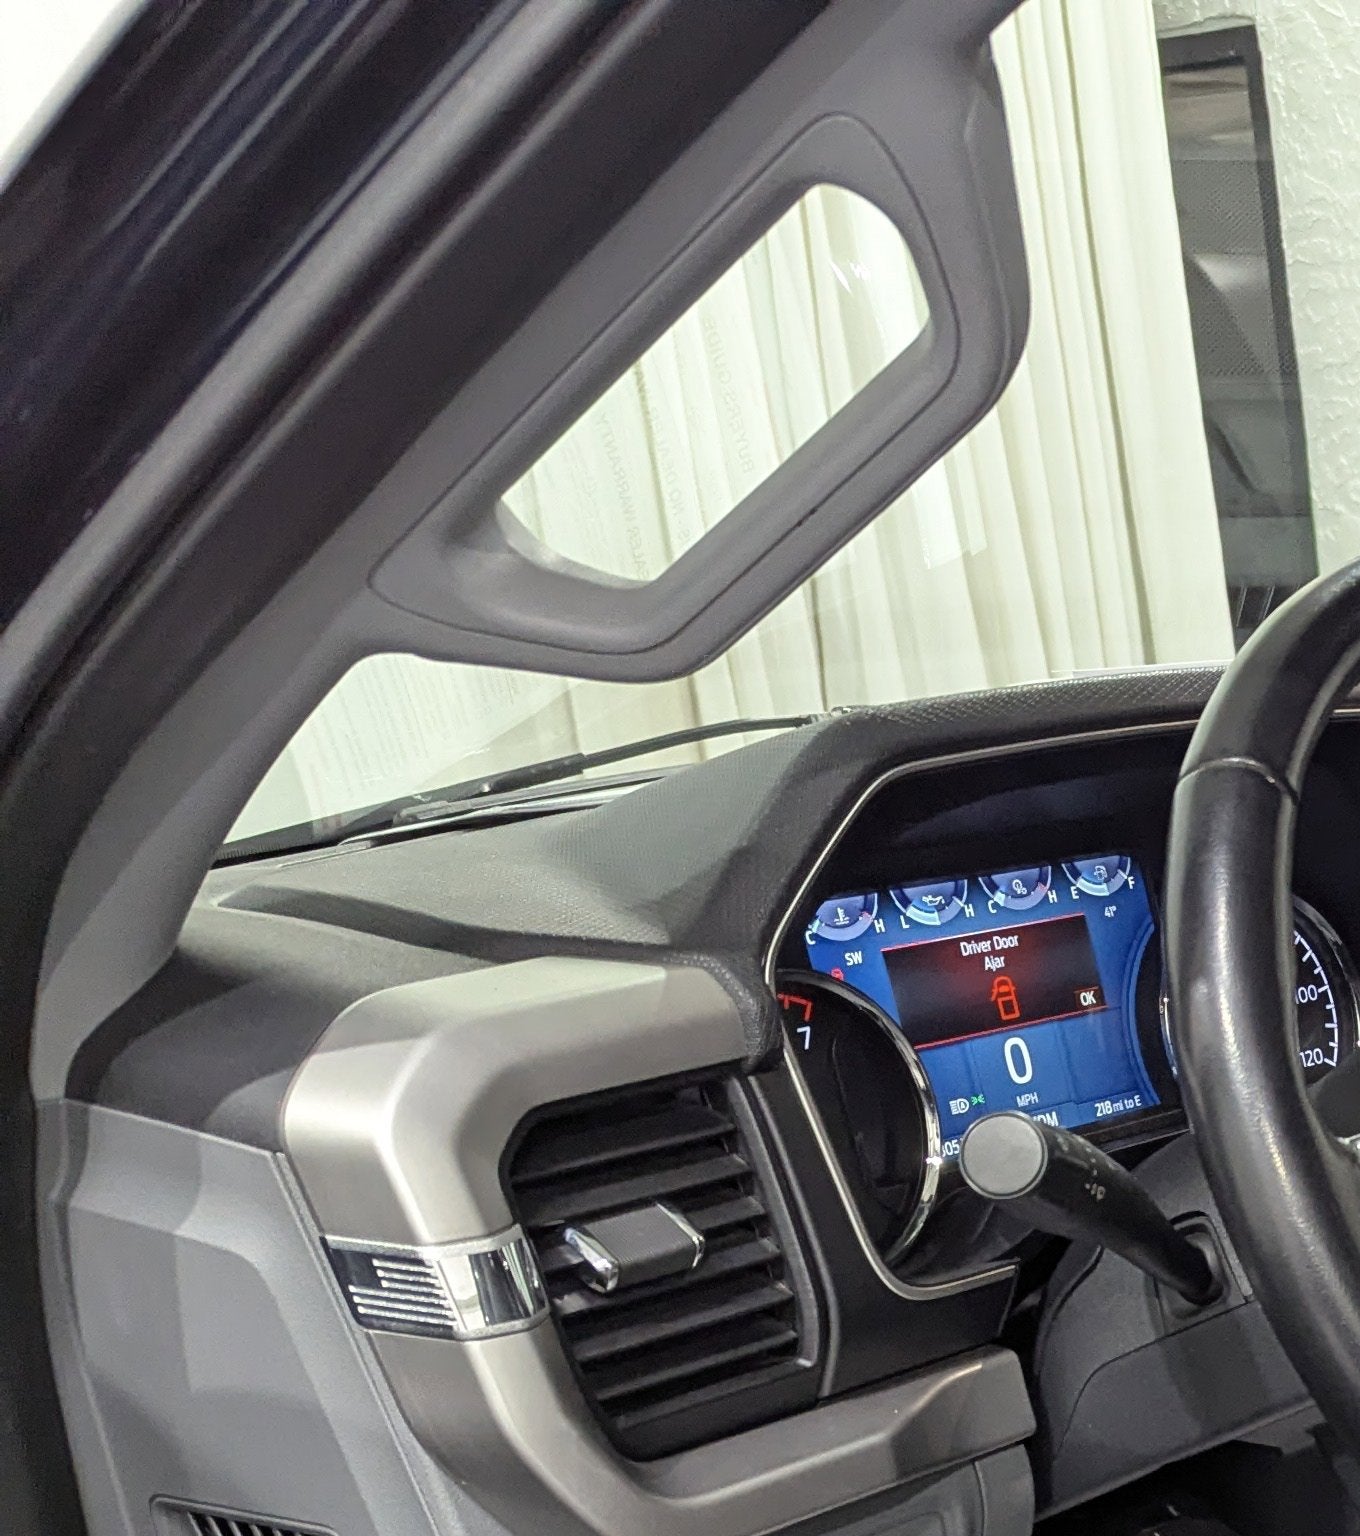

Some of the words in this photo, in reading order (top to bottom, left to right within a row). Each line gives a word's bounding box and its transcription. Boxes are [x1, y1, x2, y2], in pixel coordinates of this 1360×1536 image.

[1128, 876, 1135, 890] F
[1047, 890, 1058, 903] H
[1071, 887, 1079, 900] E
[964, 904, 975, 918] H
[988, 902, 997, 914] C
[874, 918, 886, 934] H
[900, 915, 910, 929] L
[805, 930, 816, 945] C
[960, 938, 992, 957] Driver
[993, 934, 1020, 951] Door
[844, 950, 863, 966] SW
[984, 954, 1006, 972] Ajar
[1079, 990, 1097, 1006] OK
[796, 1026, 811, 1050] 7
[1003, 1036, 1034, 1084] 0
[1300, 1047, 1324, 1068] 120
[1016, 1092, 1039, 1108] MPH
[1094, 1101, 1113, 1117] 218
[1112, 1099, 1124, 1113] mi
[1124, 1098, 1134, 1109] to
[1134, 1094, 1142, 1107] E
